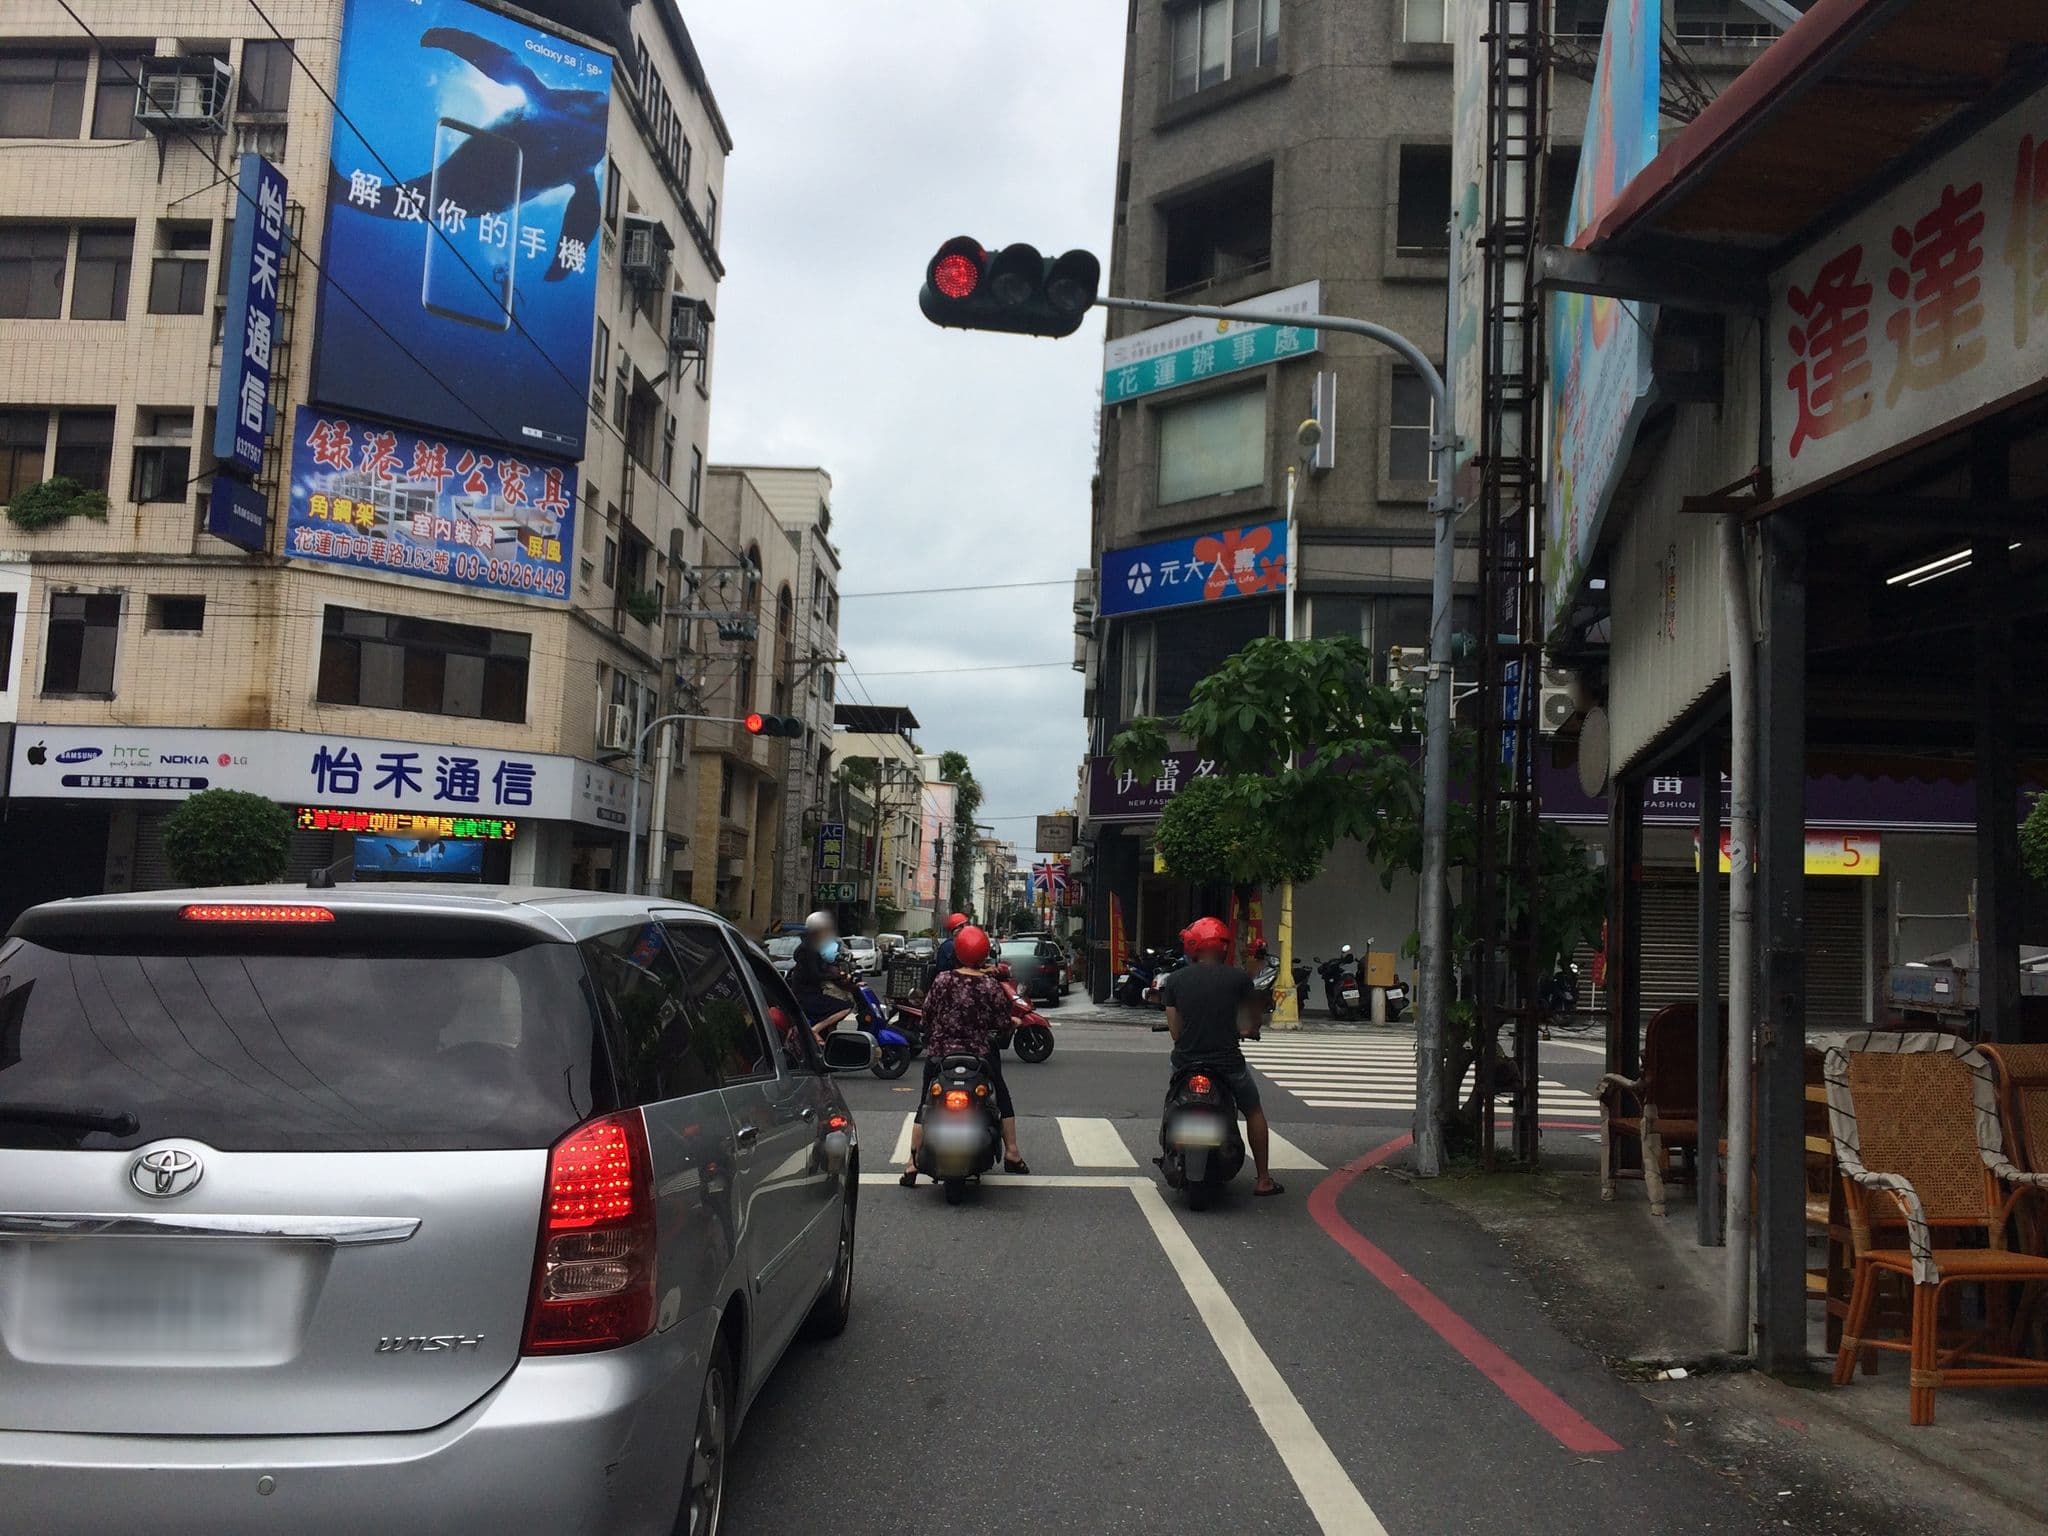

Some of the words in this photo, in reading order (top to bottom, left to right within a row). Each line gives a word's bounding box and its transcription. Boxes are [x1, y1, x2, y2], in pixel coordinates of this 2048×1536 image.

[524, 38, 563, 63] Galaxy
[563, 54, 577, 68] S8
[586, 63, 604, 76] S8+
[348, 168, 587, 274] 解放你的手機
[240, 176, 284, 434] 怡禾通信
[1117, 326, 1301, 396] 花蓮辦事處
[233, 503, 262, 527] SAMSUNG
[308, 494, 376, 528] 角鋼架
[412, 512, 496, 550] 室內裝潢
[294, 526, 450, 575] 花蓮市中華路152號
[455, 552, 567, 595] 03-8326442
[527, 535, 562, 563] 屏風
[1159, 547, 1256, 587] 元大人壽
[1208, 578, 1237, 588] Yuanta
[1239, 574, 1255, 584] Life
[60, 751, 98, 760] SAMSUNG
[160, 754, 209, 765] NOKIA
[233, 756, 248, 766] LG
[311, 745, 537, 806] 怡禾通信
[1128, 799, 1146, 807] NEW
[1149, 798, 1170, 806] FASH
[1643, 800, 1697, 810] FASHION
[1843, 835, 1861, 868] 5
[375, 1334, 485, 1353] WISH
